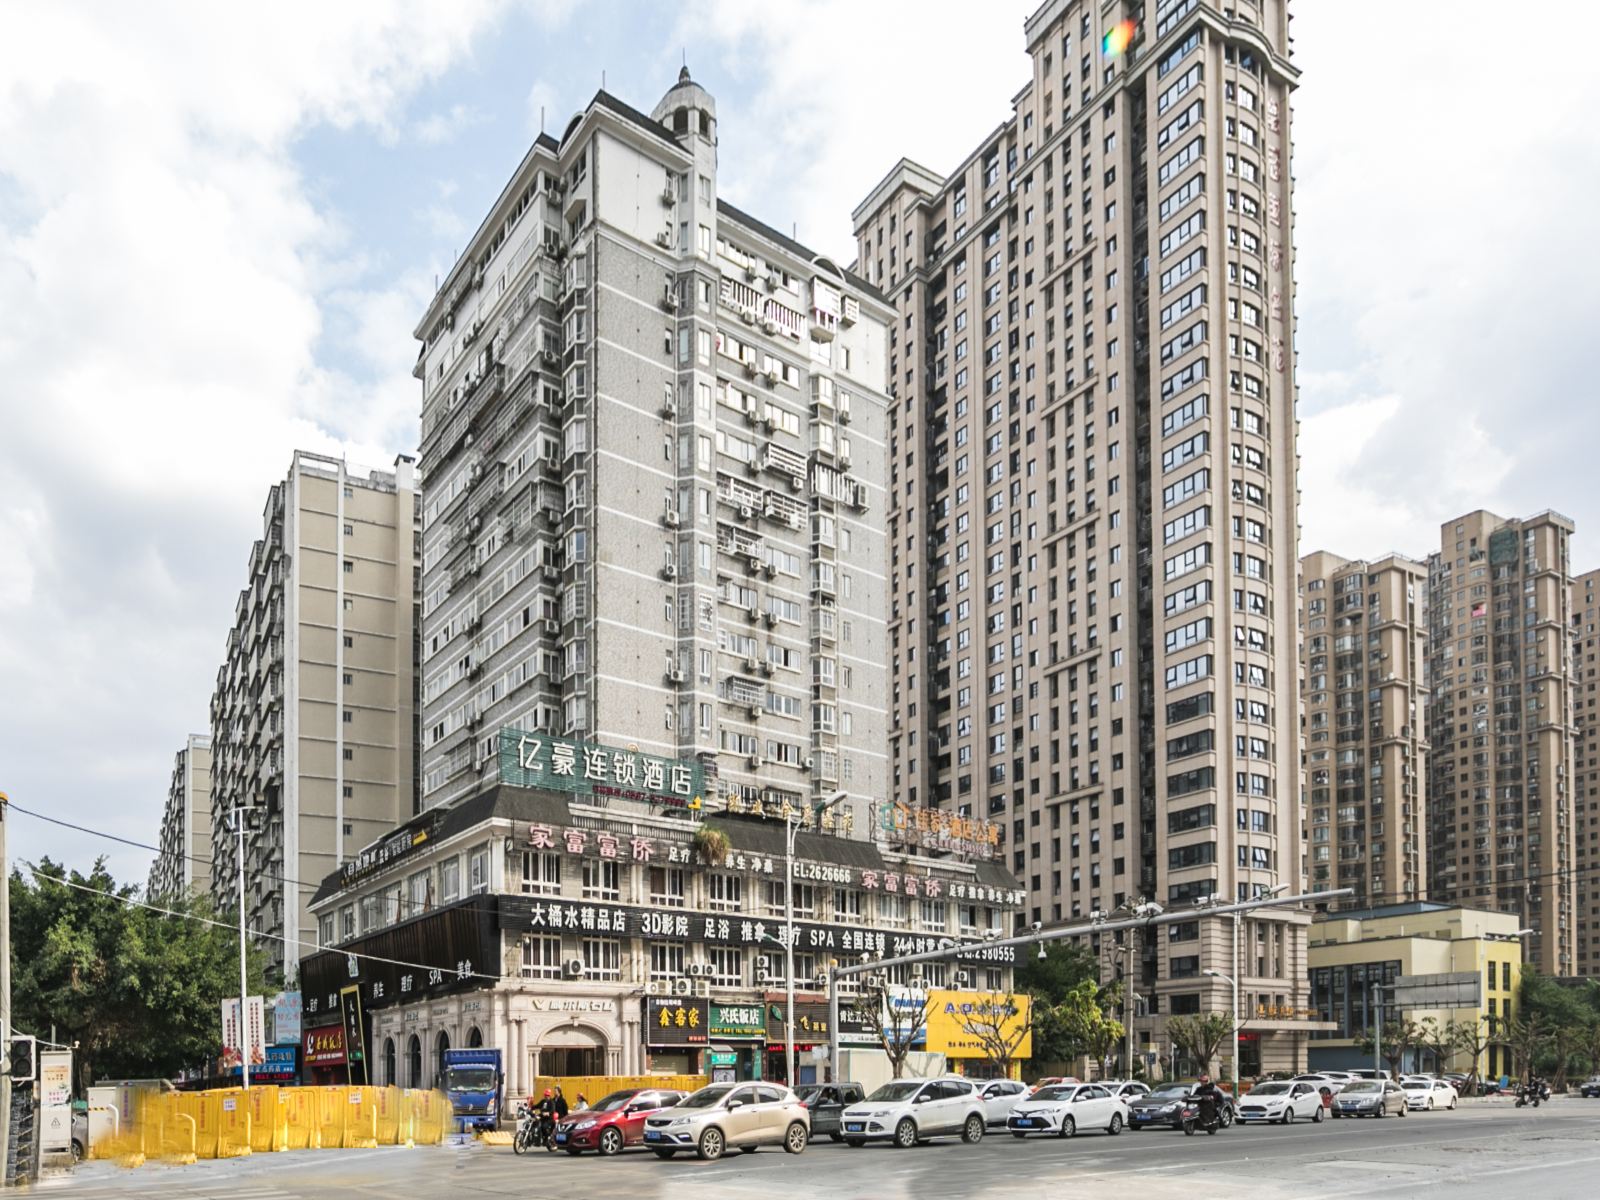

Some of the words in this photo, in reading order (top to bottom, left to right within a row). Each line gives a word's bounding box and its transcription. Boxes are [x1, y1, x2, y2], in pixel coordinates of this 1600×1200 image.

[517, 734, 692, 796] 亿豪连锁酒店
[528, 824, 654, 861] 家富富侨
[668, 846, 691, 864] 足疗
[725, 853, 746, 870] 养生
[787, 861, 851, 883] EL:2626666
[861, 870, 941, 898] 家富富侨
[530, 902, 627, 933] 大桶水精品店
[641, 912, 689, 937] 3D影院
[703, 918, 730, 940] 足浴
[740, 920, 766, 943] 推拿
[810, 929, 835, 948] SPA
[842, 929, 886, 952] 全国连锁
[429, 968, 443, 986] SPA
[659, 1006, 700, 1029] 鑫客家
[719, 1008, 760, 1026] 兴氏饭店
